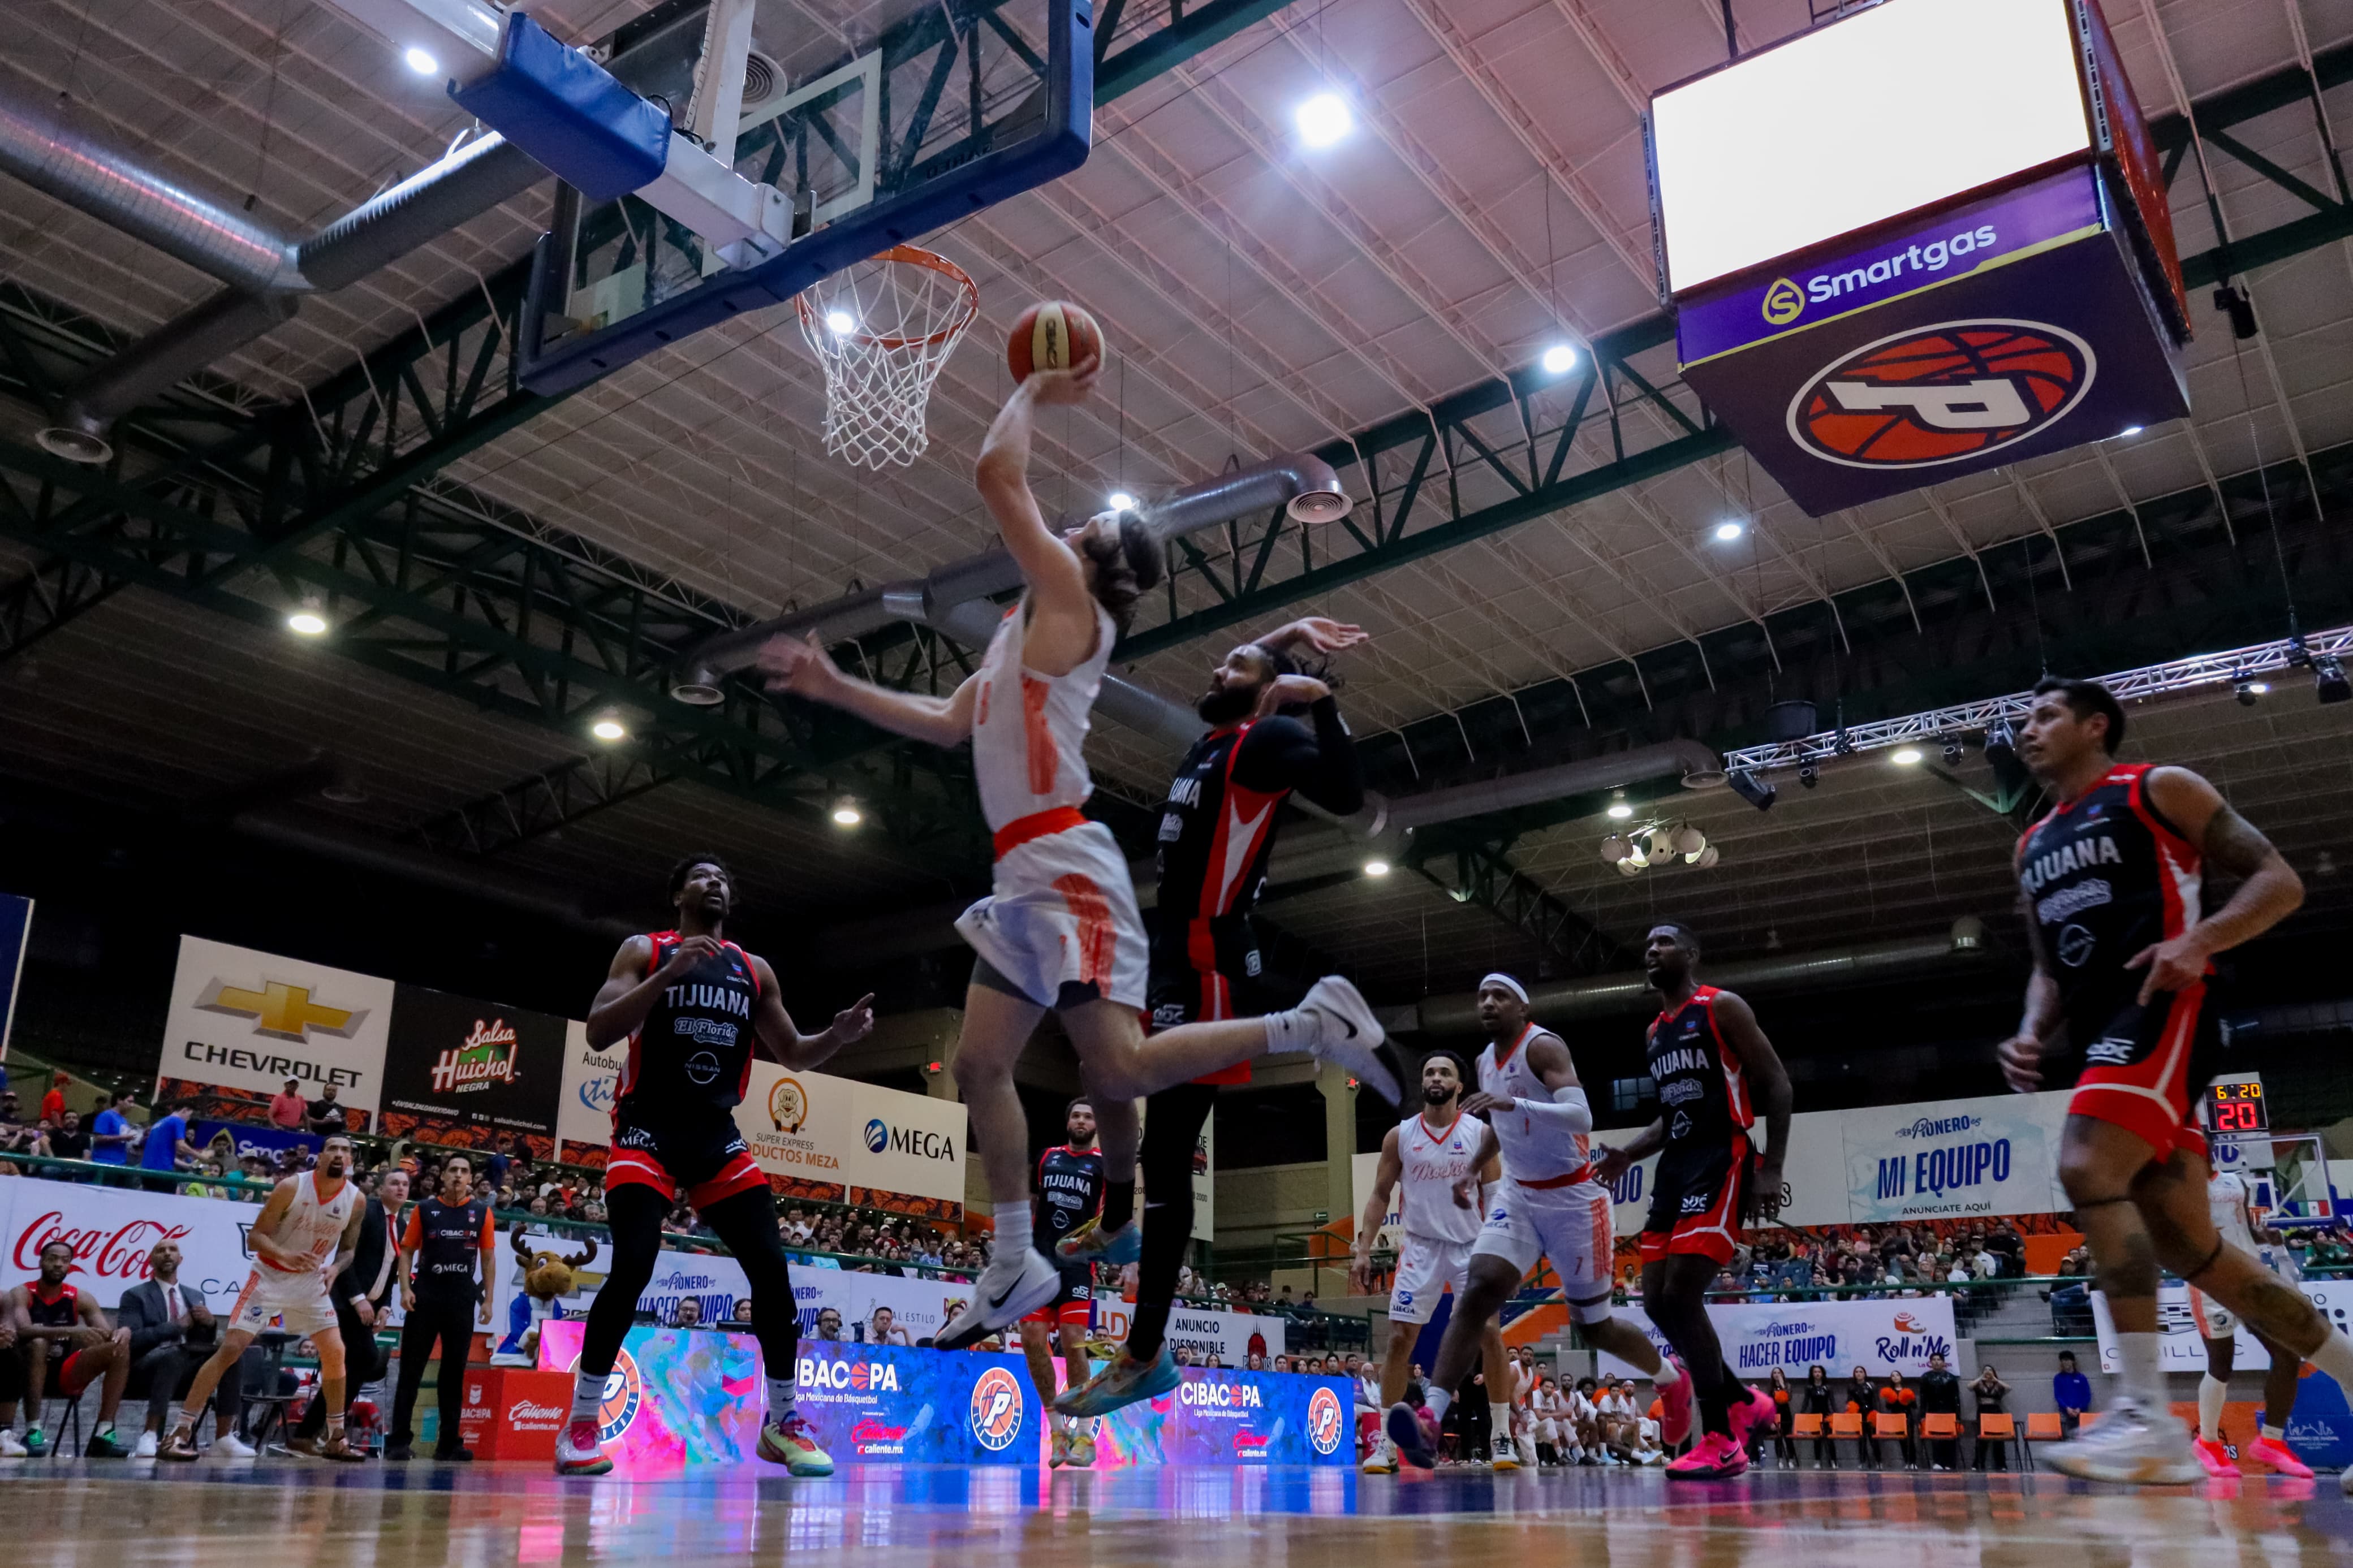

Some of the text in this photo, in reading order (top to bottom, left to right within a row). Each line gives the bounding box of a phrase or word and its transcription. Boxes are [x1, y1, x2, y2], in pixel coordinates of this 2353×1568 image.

[1808, 225, 1997, 303] Smartgas
[665, 984, 749, 1020] TIJUANA
[462, 1019, 516, 1051] Salsa
[677, 1020, 737, 1039] El Florido
[184, 1041, 363, 1088] CHEVROLET
[432, 1044, 517, 1090] Huichol
[684, 1063, 720, 1073] NISSAN
[455, 1082, 490, 1093] NEGRA
[494, 1117, 548, 1130] salsahuichol.com
[2217, 1103, 2258, 1130] 20
[1912, 1115, 1970, 1139] PIONERO
[756, 1132, 814, 1151] SUPER EXPRESS
[890, 1126, 954, 1162] MEGA
[806, 1153, 839, 1170] MEZA
[1877, 1138, 2010, 1200] MI EQUIPO
[1044, 1174, 1091, 1196] TIJUANA
[1964, 1201, 1990, 1212] AQUÍ
[443, 1263, 468, 1273] MEGA
[668, 1271, 708, 1291] PIONERO
[906, 1312, 935, 1324] ESTILO
[1175, 1318, 1219, 1334] ANUNCIO
[1766, 1322, 1807, 1338] PIONERO
[1739, 1334, 1835, 1368] HACER EQUIPO
[1876, 1336, 1910, 1363] Roll
[805, 1392, 834, 1403] Mexicana
[835, 1393, 843, 1403] de
[844, 1393, 877, 1405] Básquetbol
[1181, 1381, 1261, 1407] CIBACOPA
[508, 1399, 563, 1422] Caliente
[521, 1421, 560, 1431] caliente.mx
[864, 1444, 903, 1454] caliente.mx
